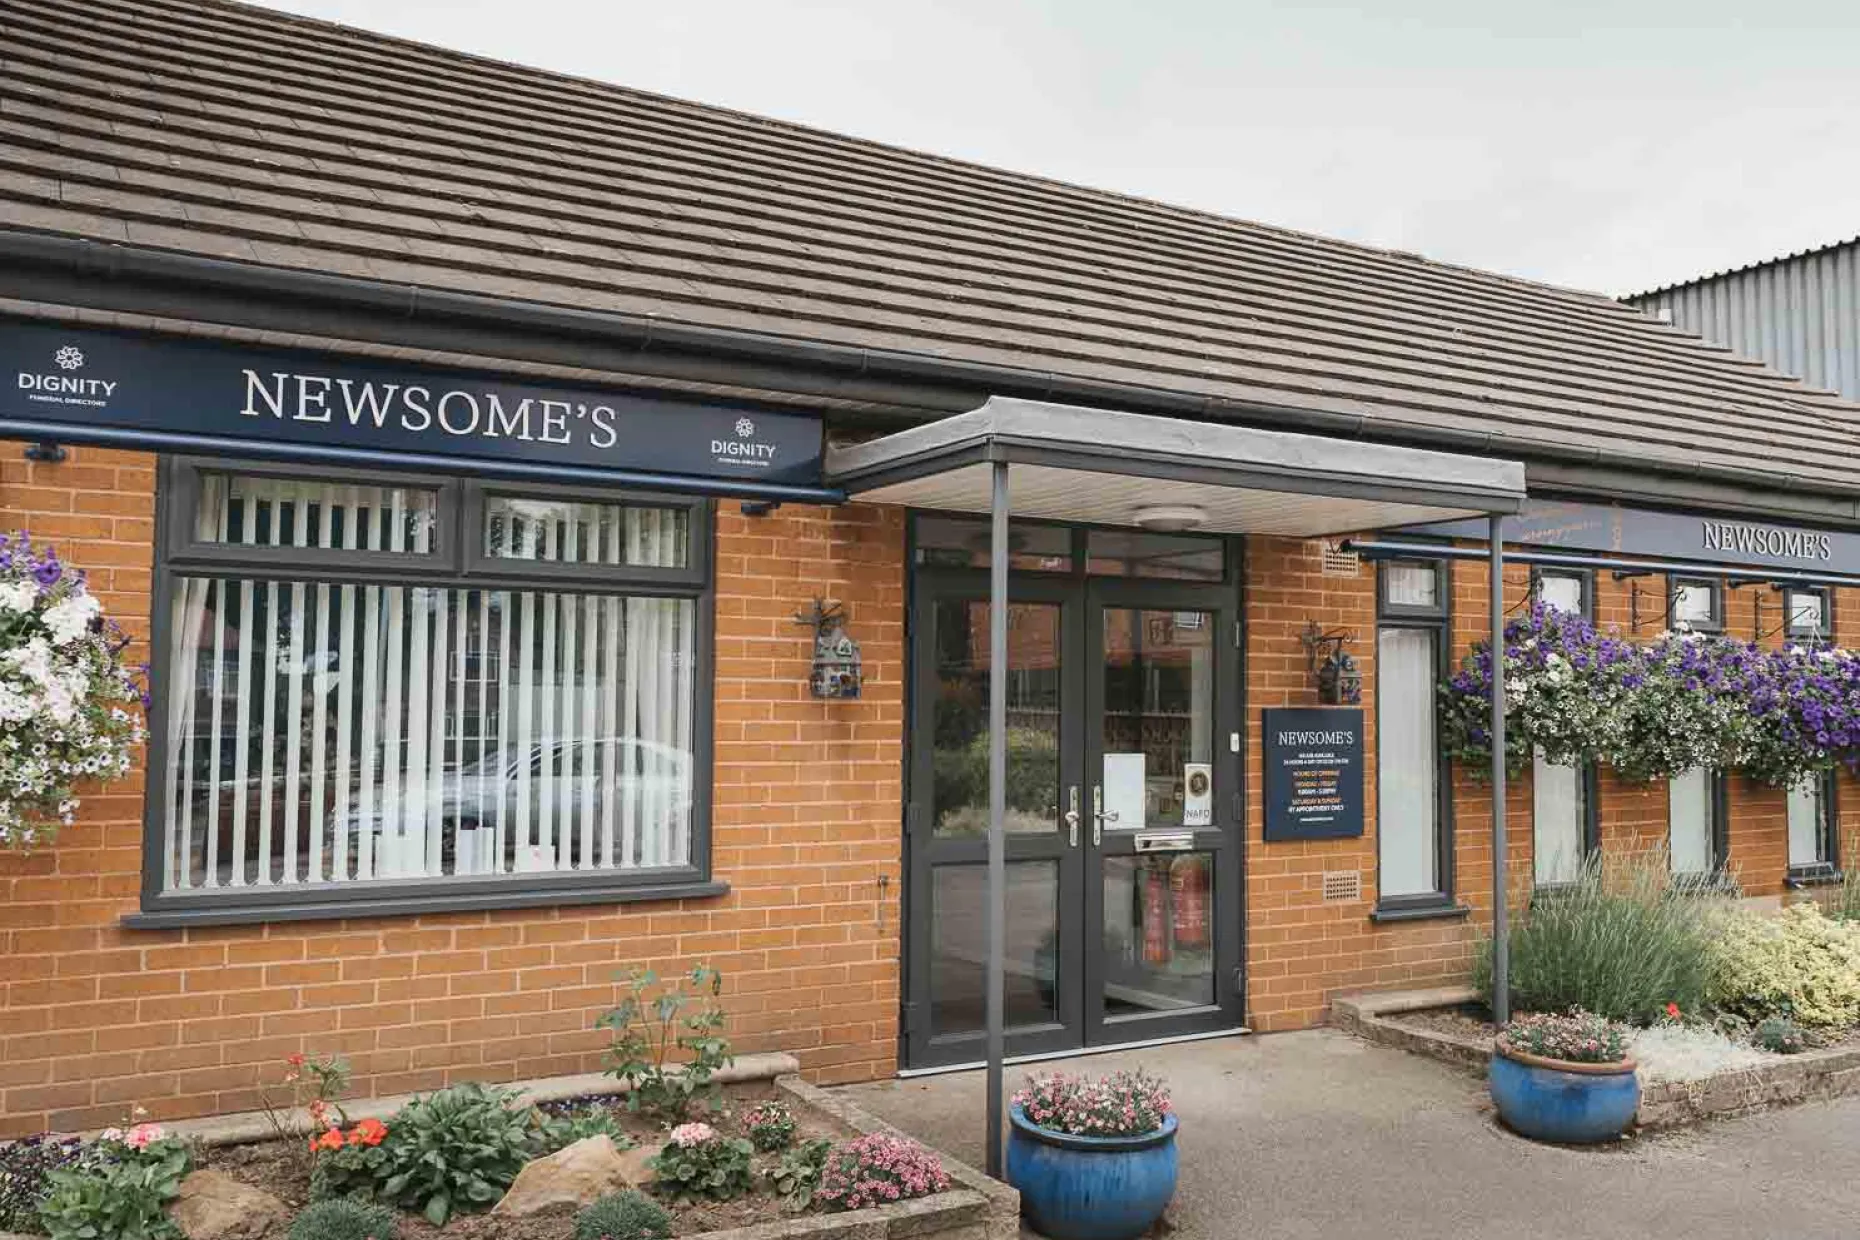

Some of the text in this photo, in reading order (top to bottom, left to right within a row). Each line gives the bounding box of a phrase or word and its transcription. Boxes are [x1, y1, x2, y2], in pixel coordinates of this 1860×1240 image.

[18, 373, 117, 396] DIGNITY
[239, 368, 618, 449] NEWSOME'S
[711, 440, 776, 458] DIGNITY
[1702, 521, 1831, 560] NEWSOME'S
[1278, 731, 1354, 746] NEWSOME'S
